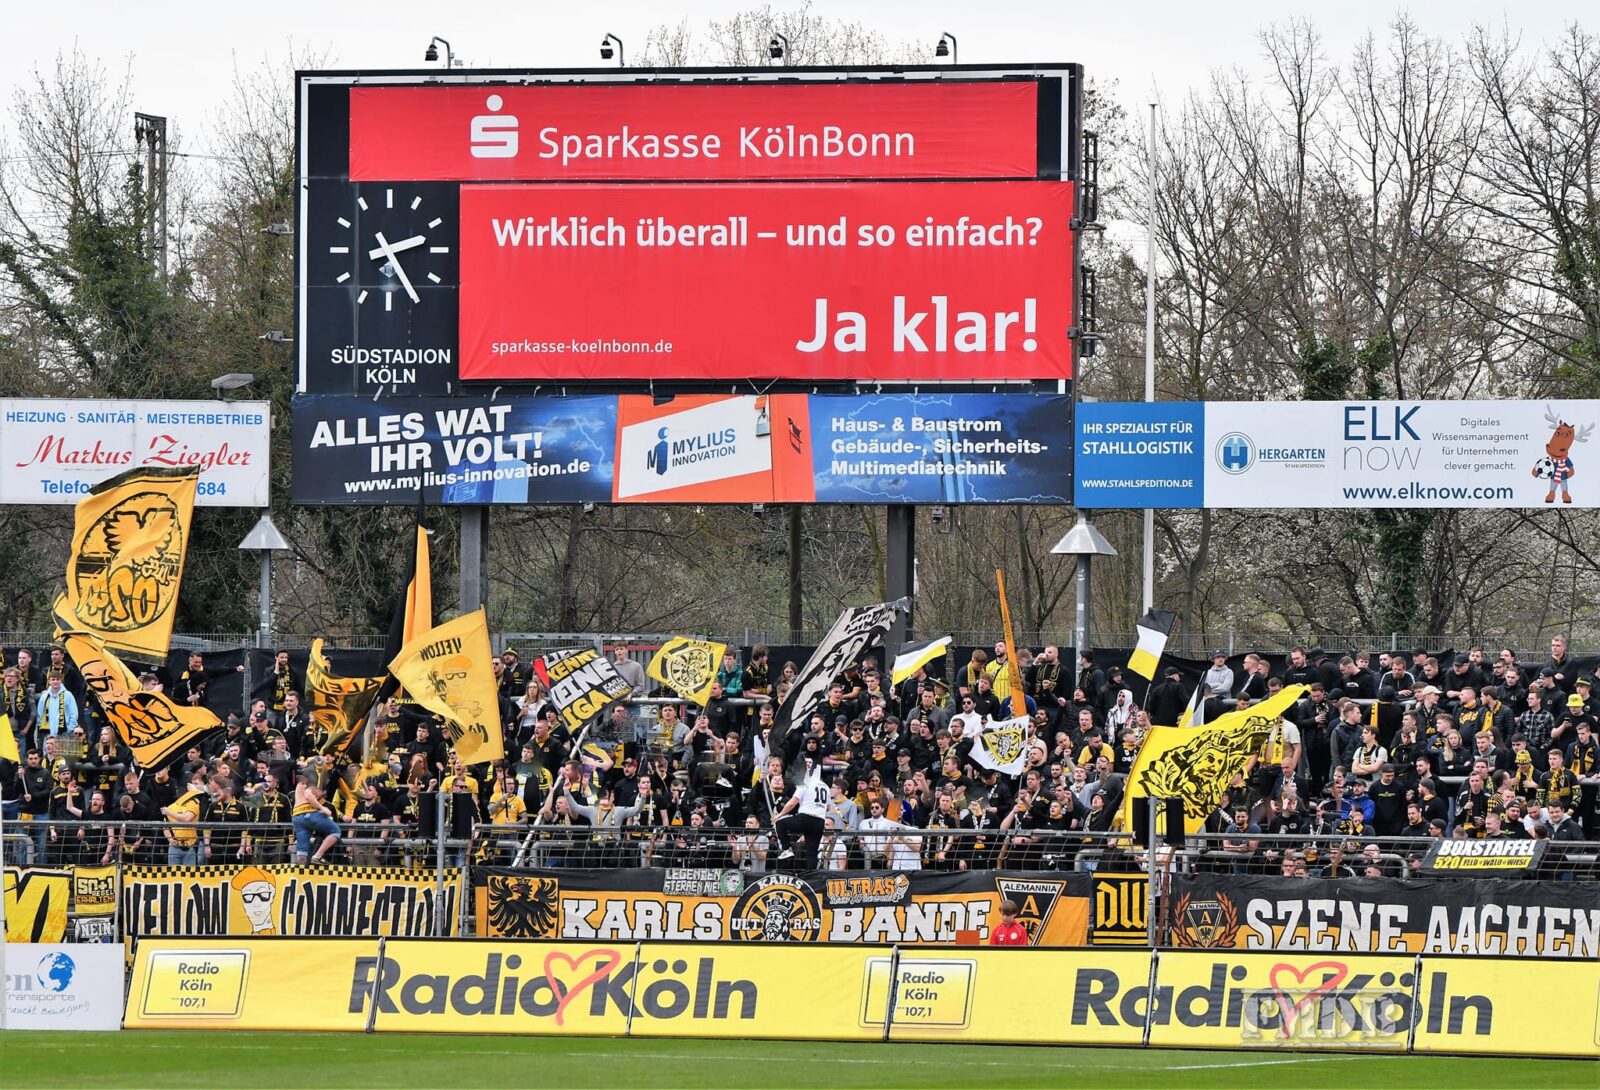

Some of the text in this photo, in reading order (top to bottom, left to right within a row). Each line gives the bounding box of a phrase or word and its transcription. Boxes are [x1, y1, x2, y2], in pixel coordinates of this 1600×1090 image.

[538, 124, 915, 166] Sparkasse KölnBonn
[491, 216, 626, 248] Wirklich
[636, 216, 749, 247] überall
[786, 216, 847, 247] und
[858, 223, 896, 247] so
[906, 216, 1043, 247] einfach?
[795, 296, 1038, 353] Ja klar!
[330, 345, 452, 365] SÜDSTADION
[491, 338, 674, 358] sparkasse-koelnbonn.de
[366, 364, 417, 385] KÖLN
[6, 409, 264, 426] HEIZUNG SANITÄR MEISTERBETRIEB
[309, 403, 513, 449] ALLES WAT
[831, 416, 1003, 433] Haus- & Baustrom
[1343, 405, 1422, 441] ELK
[1460, 417, 1501, 428] Digitales
[1082, 420, 1193, 435] IHR SPEZIALIST FÜR
[672, 427, 737, 456] MYLIUS
[1432, 432, 1529, 442] Wissensmanagement
[15, 434, 253, 473] Markus Ziegler
[370, 431, 544, 474] IHR VOLT!
[831, 438, 1049, 456] Gebäude-, Sicherheits-
[1082, 440, 1194, 455] STAHLLOGISTIK
[1258, 448, 1326, 460] HERGARTEN
[1441, 447, 1519, 456] für Unternehmen
[671, 444, 737, 468] INNOVATION
[1343, 446, 1422, 471] now
[831, 460, 1007, 476] Multimediatechnik
[1444, 461, 1517, 472] clever gemacht.
[344, 457, 592, 494] www.mylius-innovation.de
[1081, 479, 1194, 489] WWW.STAHLSPEDITION.DE
[1342, 481, 1514, 500] www.elknow.com
[814, 786, 828, 804] 10
[1438, 839, 1538, 856] BOXSTAFFEL
[1433, 855, 1462, 869] 520
[756, 875, 806, 890] KARLS
[826, 877, 895, 897] ULTRAS
[1003, 883, 1058, 893] ALEMANNIA
[561, 898, 992, 943] KARLS BANDE
[1245, 897, 1600, 957] SZENE AACHEN
[81, 922, 112, 937] NEIN
[177, 962, 220, 975] Radio
[180, 979, 213, 991] Köln
[348, 952, 758, 1020] Radio Köln
[901, 971, 945, 985] Radio
[8, 993, 75, 1003] ransporte
[179, 998, 206, 1008] 107,1
[904, 988, 938, 1001] Köln
[1070, 962, 1493, 1036] Radio Köln
[905, 1006, 932, 1018] 107,1
